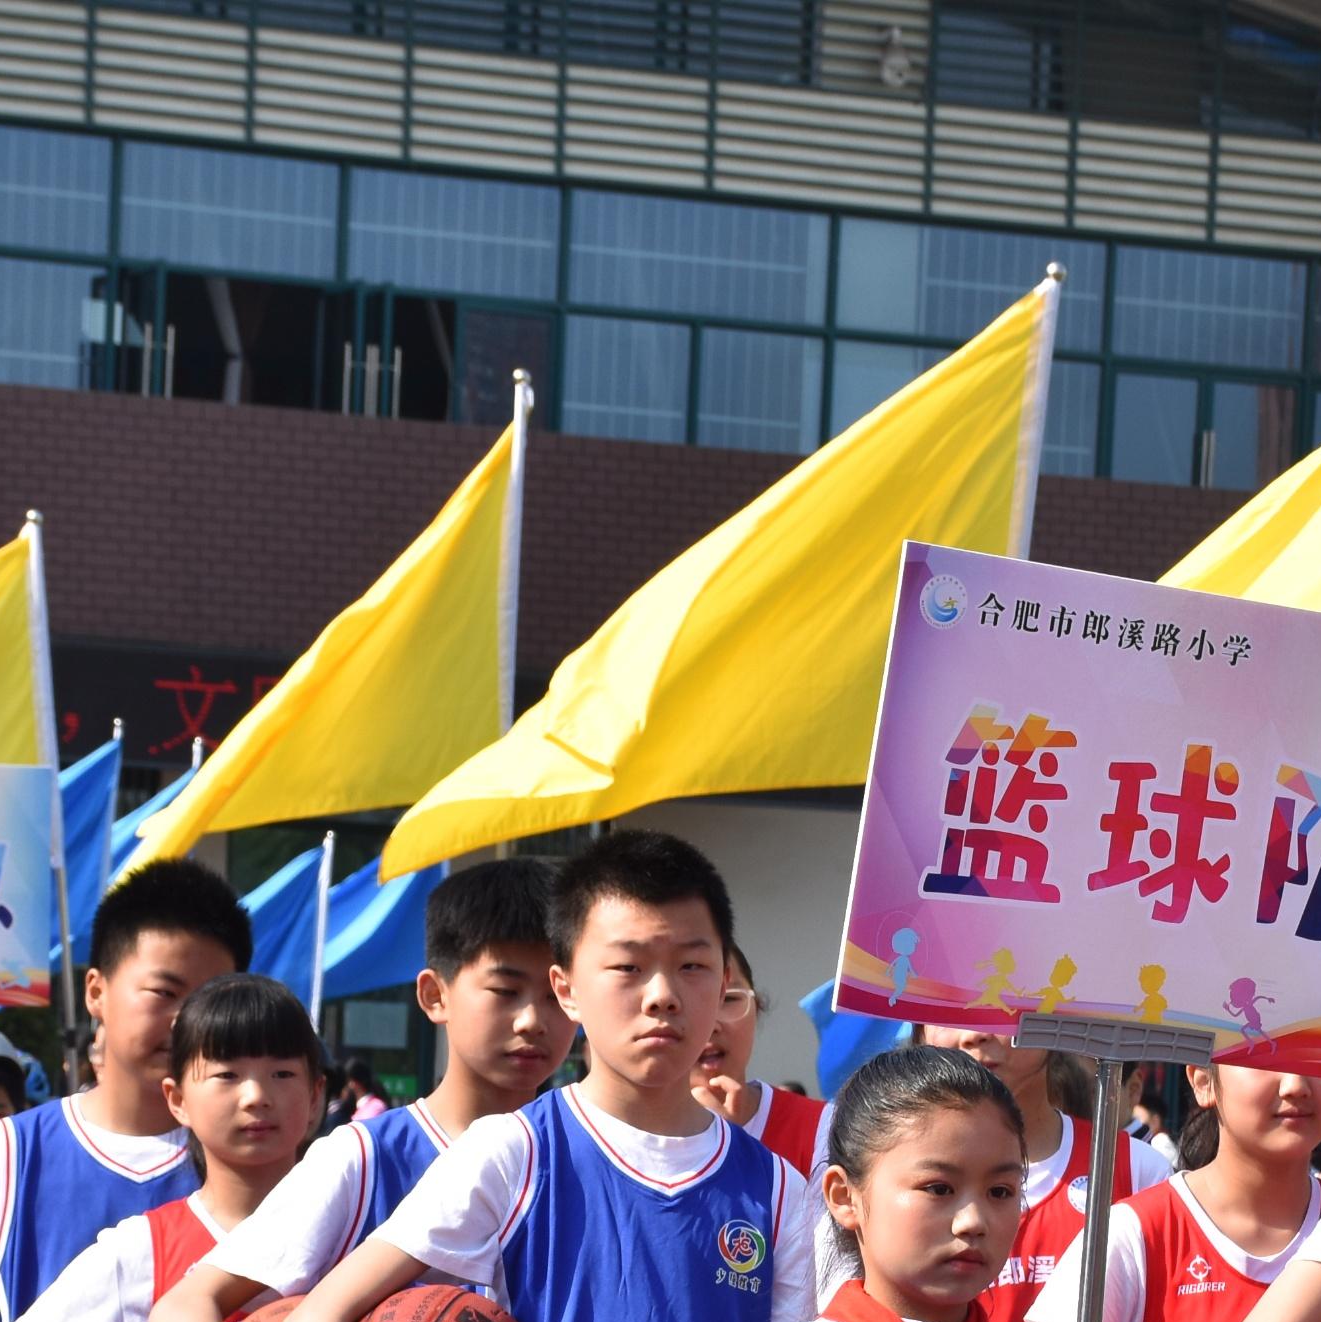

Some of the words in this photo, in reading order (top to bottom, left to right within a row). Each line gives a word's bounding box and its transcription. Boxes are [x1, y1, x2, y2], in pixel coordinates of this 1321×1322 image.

[977, 592, 1253, 666] 合肥市郎溪路小学
[981, 1255, 1056, 1293] 郎溪
[1177, 1280, 1226, 1296] RIGORER
